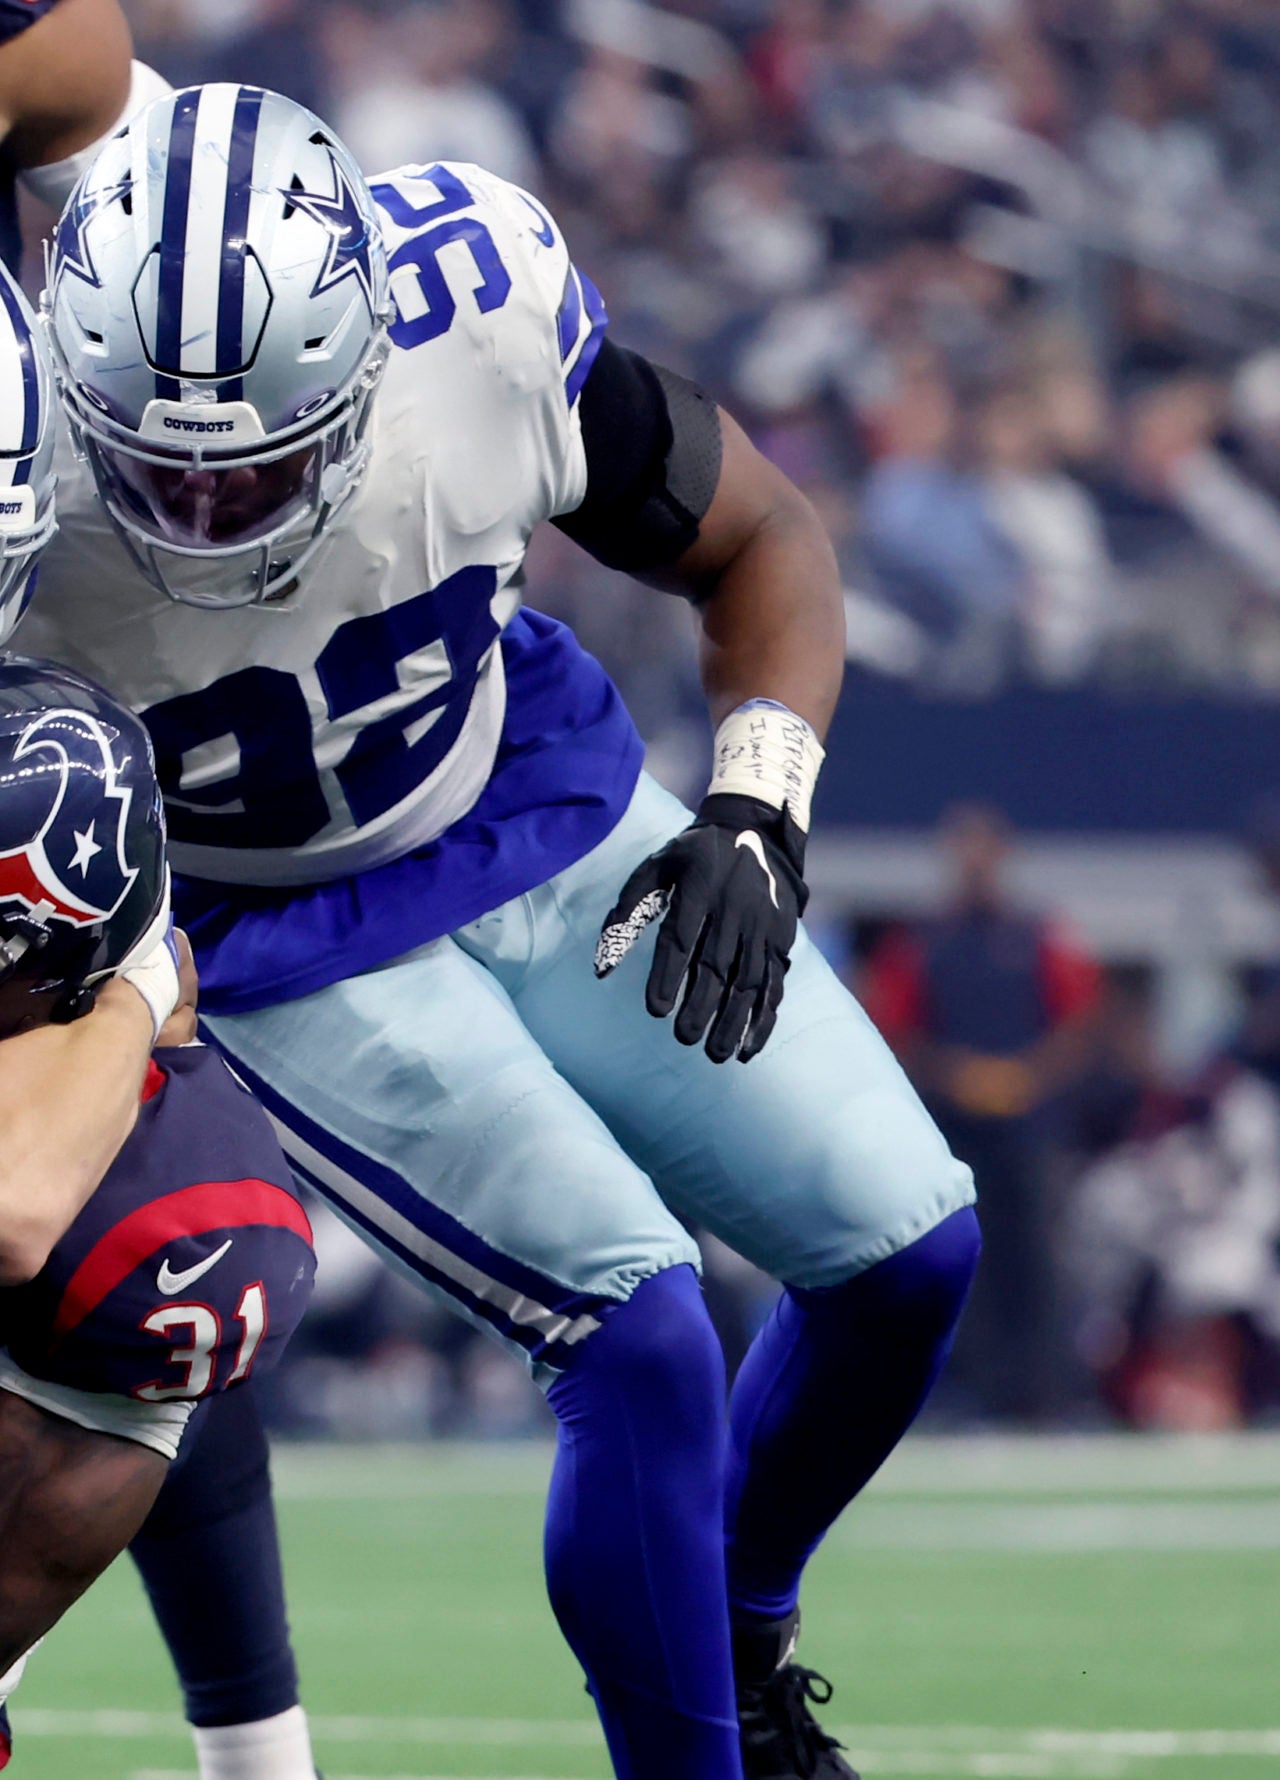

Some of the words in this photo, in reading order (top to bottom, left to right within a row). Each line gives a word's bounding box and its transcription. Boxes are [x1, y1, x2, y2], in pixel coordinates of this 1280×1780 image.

[163, 416, 235, 433] COWBOYS
[136, 564, 501, 848] 92
[131, 1280, 269, 1404] 31
